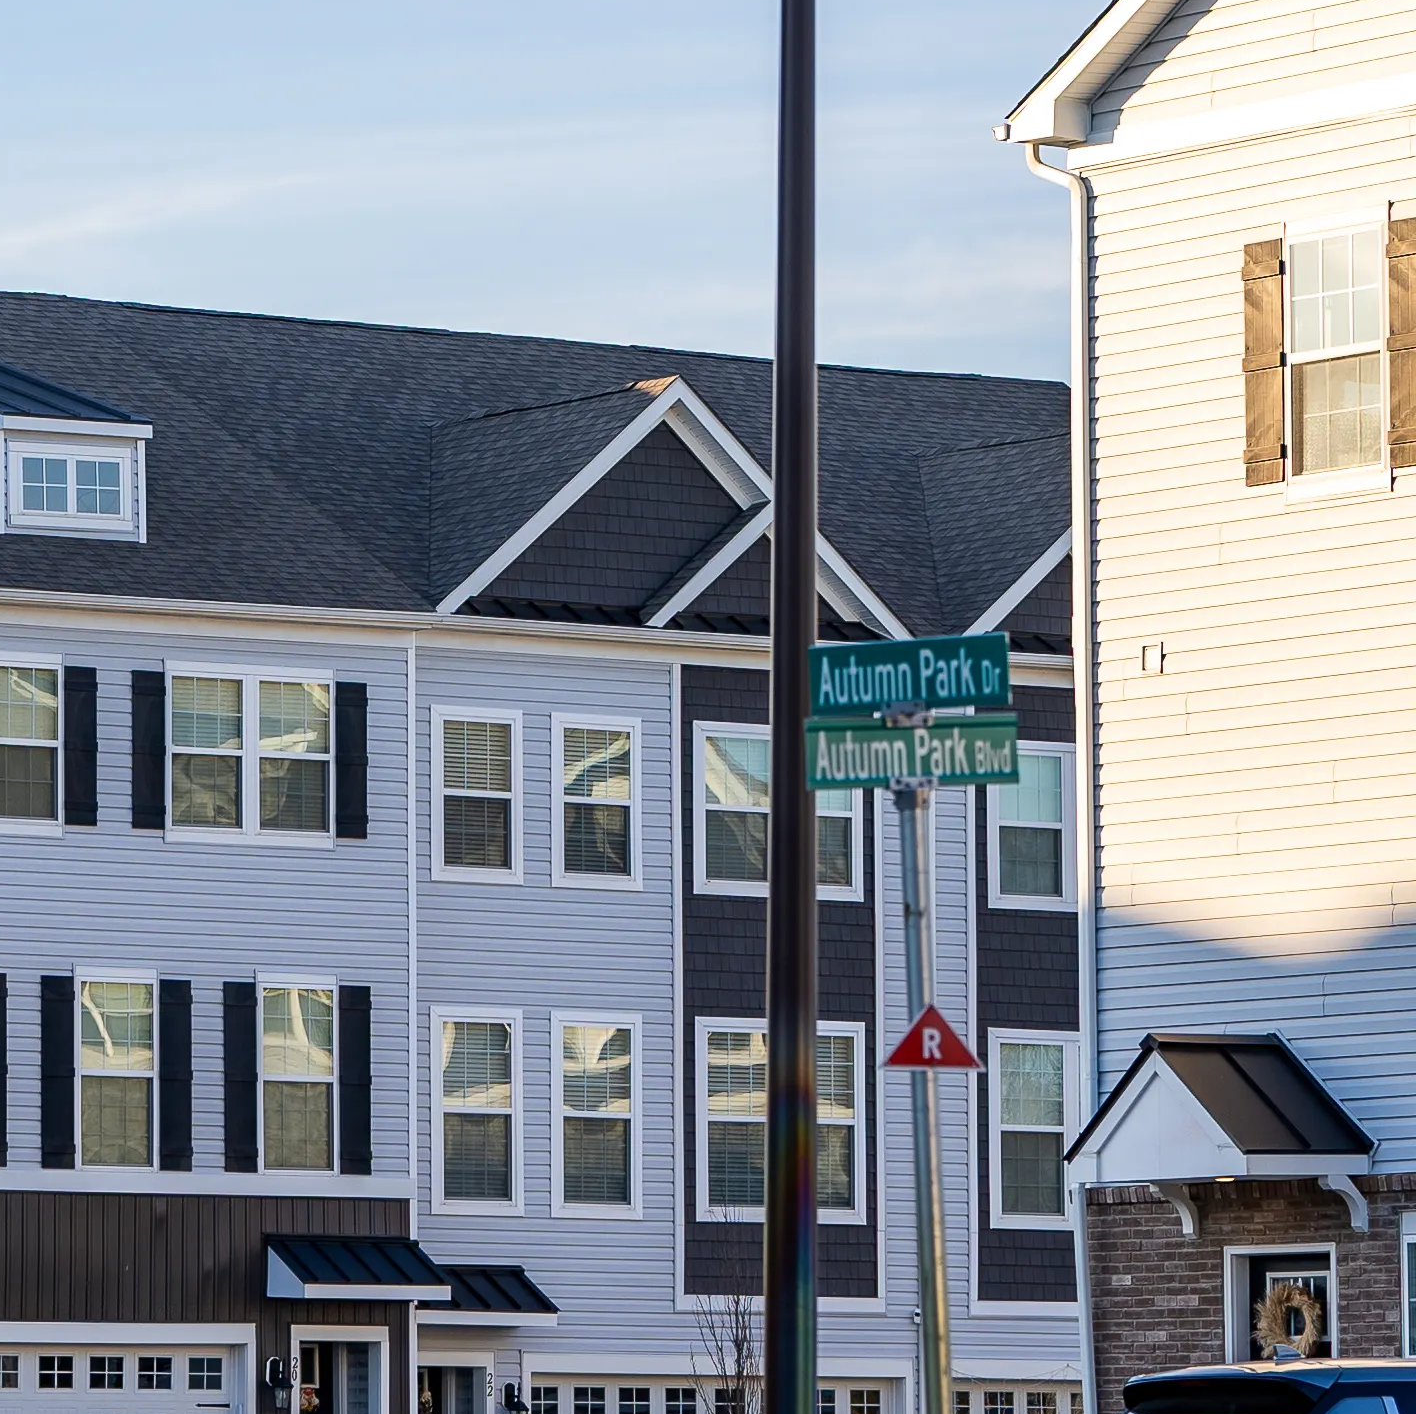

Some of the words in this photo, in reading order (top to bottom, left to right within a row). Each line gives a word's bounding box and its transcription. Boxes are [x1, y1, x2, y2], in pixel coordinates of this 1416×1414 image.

[818, 655, 912, 706] Autumn
[919, 647, 976, 699] Park
[981, 660, 1002, 694] Dr
[815, 730, 908, 781] Autumn
[913, 727, 970, 777] Park
[974, 739, 1012, 775] Blvd
[921, 1027, 943, 1060] R
[292, 1356, 298, 1382] 20
[487, 1372, 494, 1397] 22
